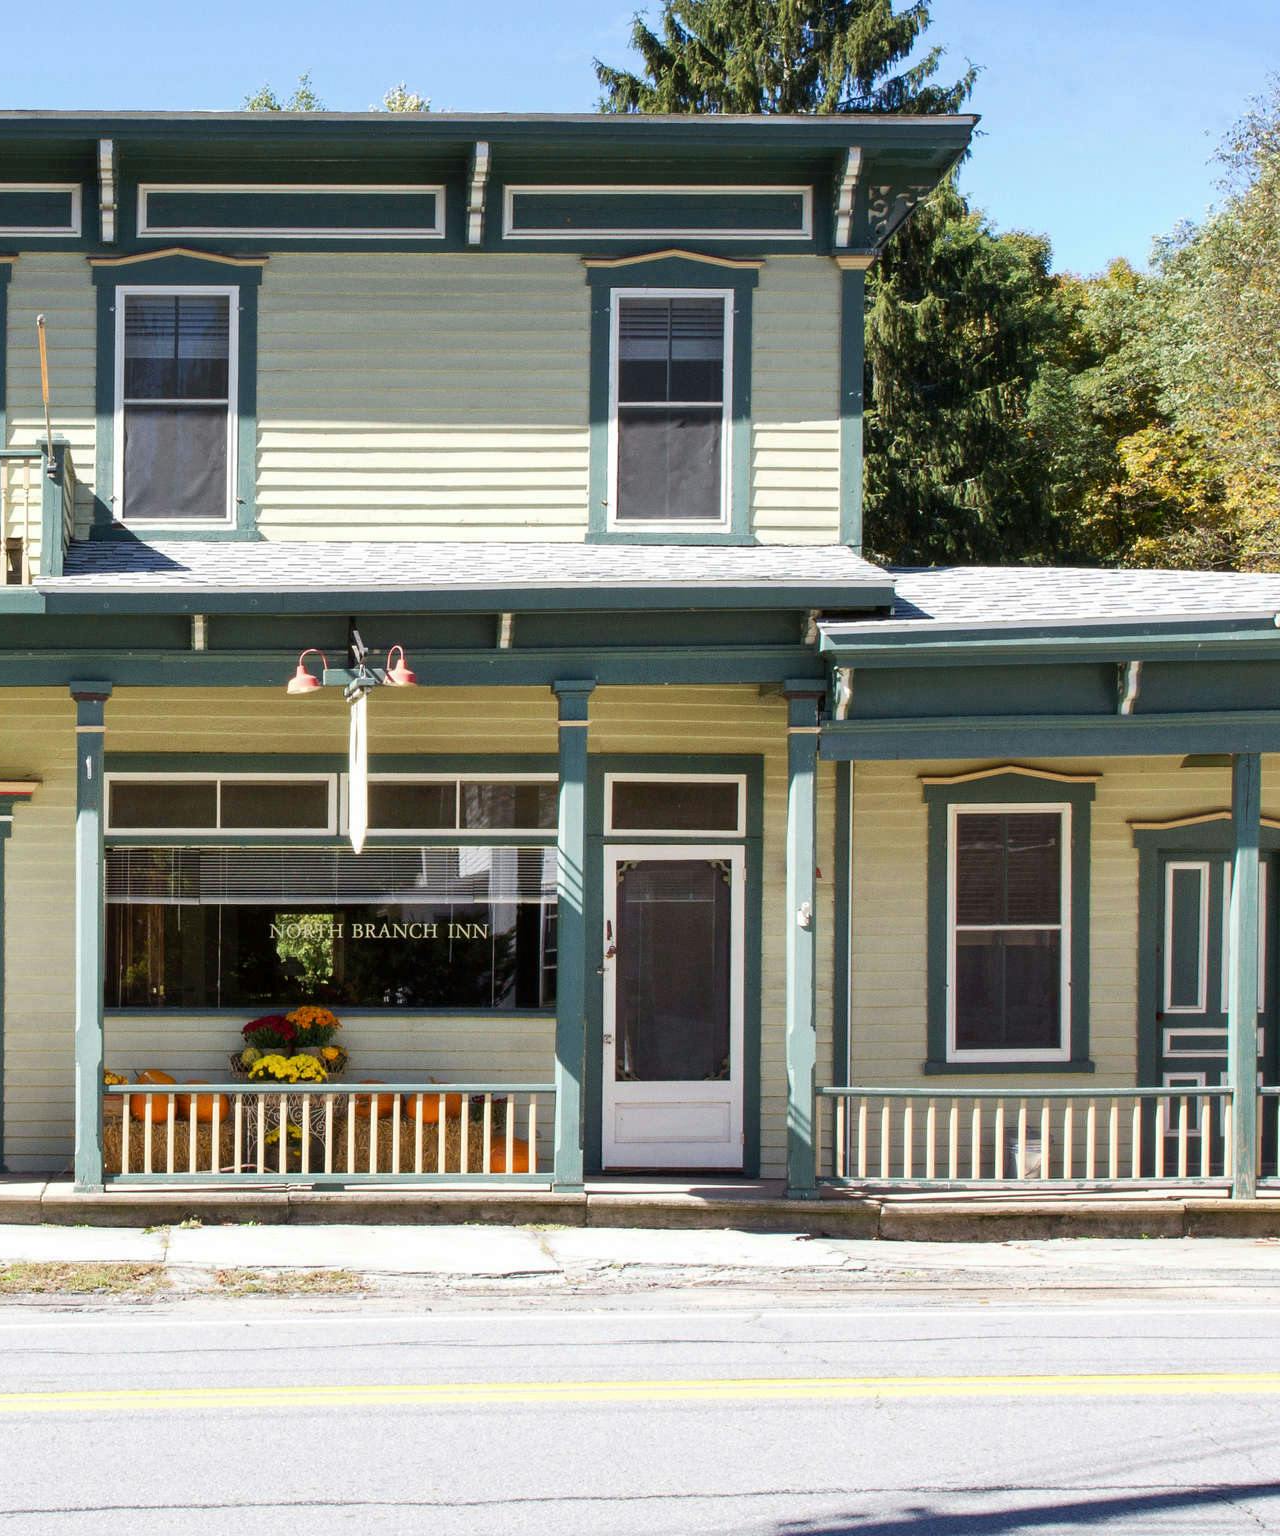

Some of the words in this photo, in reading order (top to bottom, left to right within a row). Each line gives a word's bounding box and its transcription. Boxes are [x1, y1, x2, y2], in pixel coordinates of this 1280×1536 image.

[269, 923, 344, 939] NORTH
[351, 923, 439, 939] BRANCH
[447, 923, 489, 939] INN
